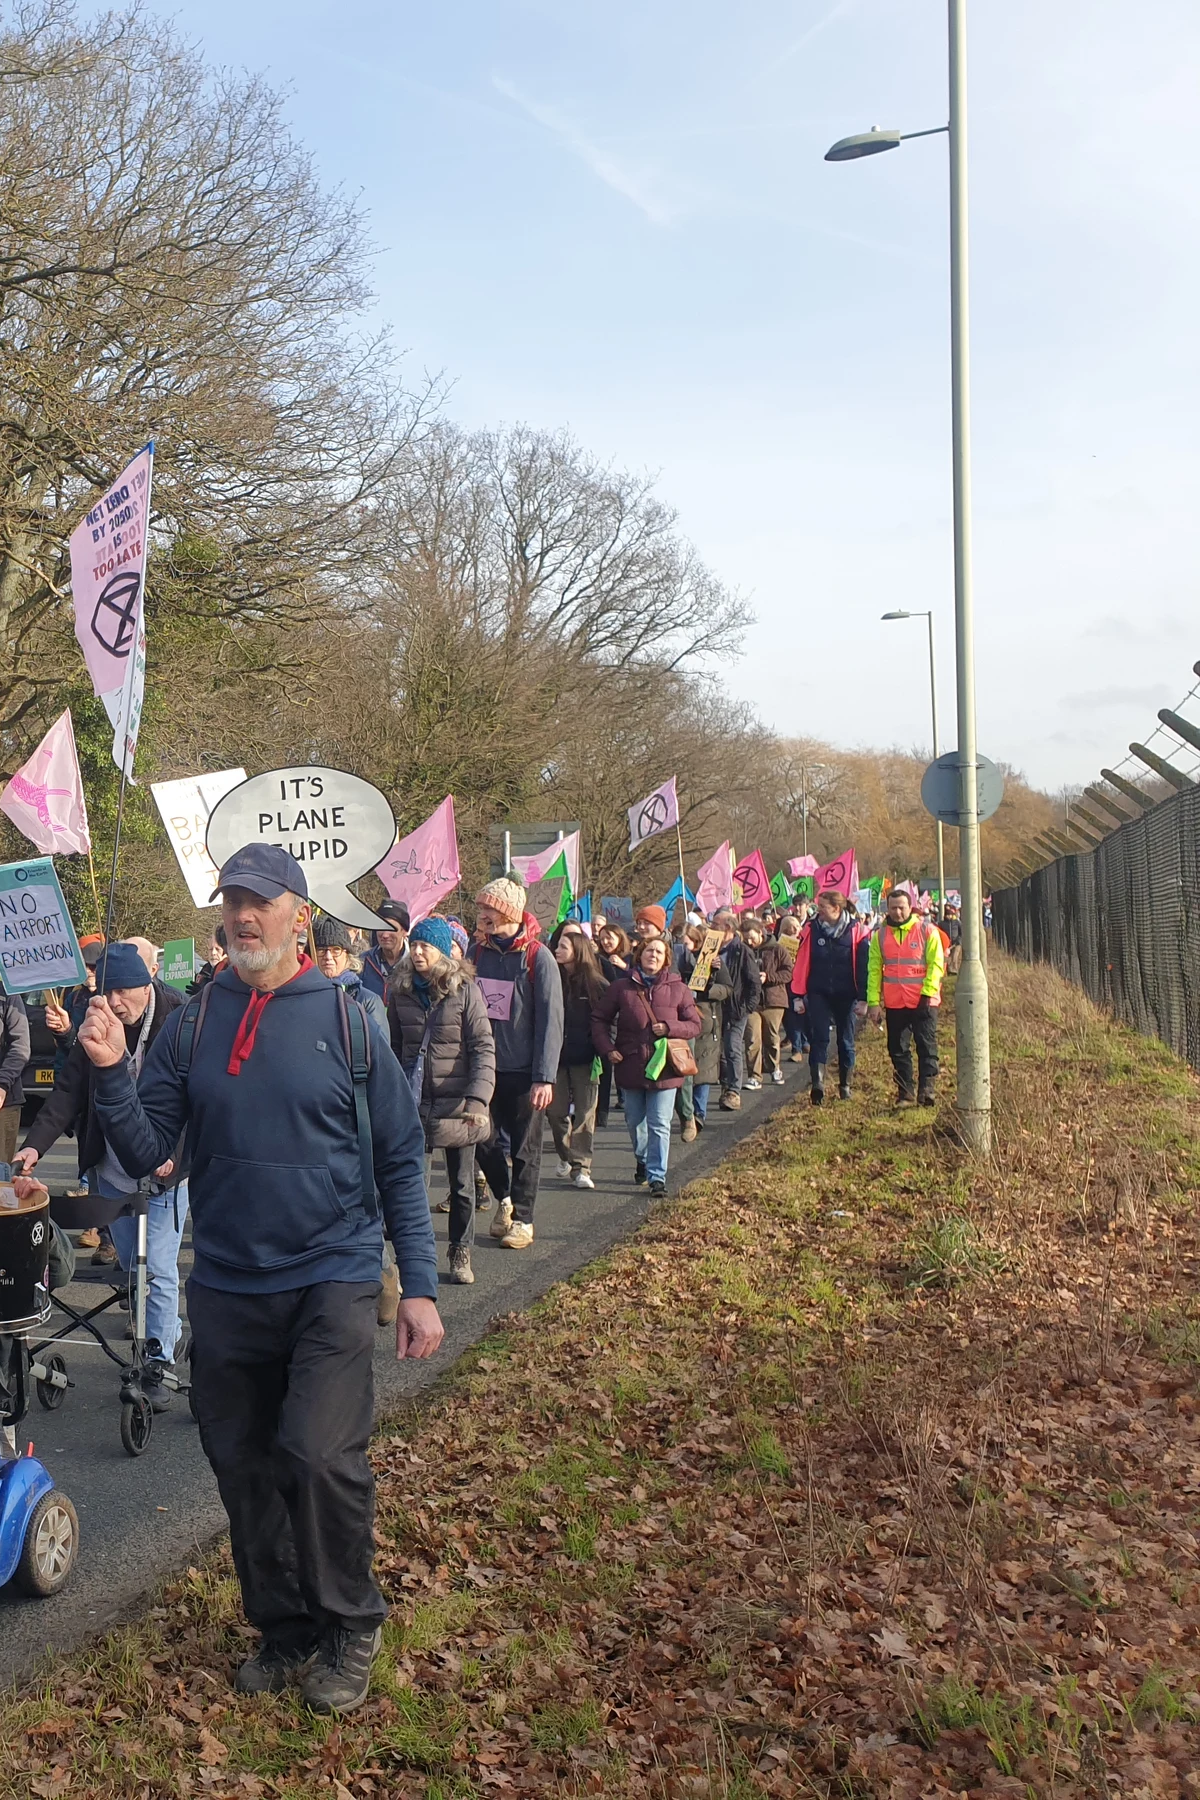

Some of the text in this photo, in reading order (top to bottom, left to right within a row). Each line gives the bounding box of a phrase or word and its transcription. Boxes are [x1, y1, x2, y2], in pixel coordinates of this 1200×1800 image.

[85, 485, 130, 527] NET ZERO
[92, 505, 131, 544] BY 2050
[113, 532, 122, 551] IS
[93, 559, 115, 581] TOO
[117, 540, 142, 566] LATE
[280, 776, 324, 800] IT'S
[259, 806, 346, 834] PLANE
[270, 838, 348, 862] UPID
[3, 912, 62, 943] AIRPORT
[1, 941, 74, 969] EXPANSION
[168, 961, 189, 971] AIRPORT
[175, 953, 183, 962] NO
[165, 969, 192, 981] EXPANSION
[41, 1071, 55, 1081] RK
